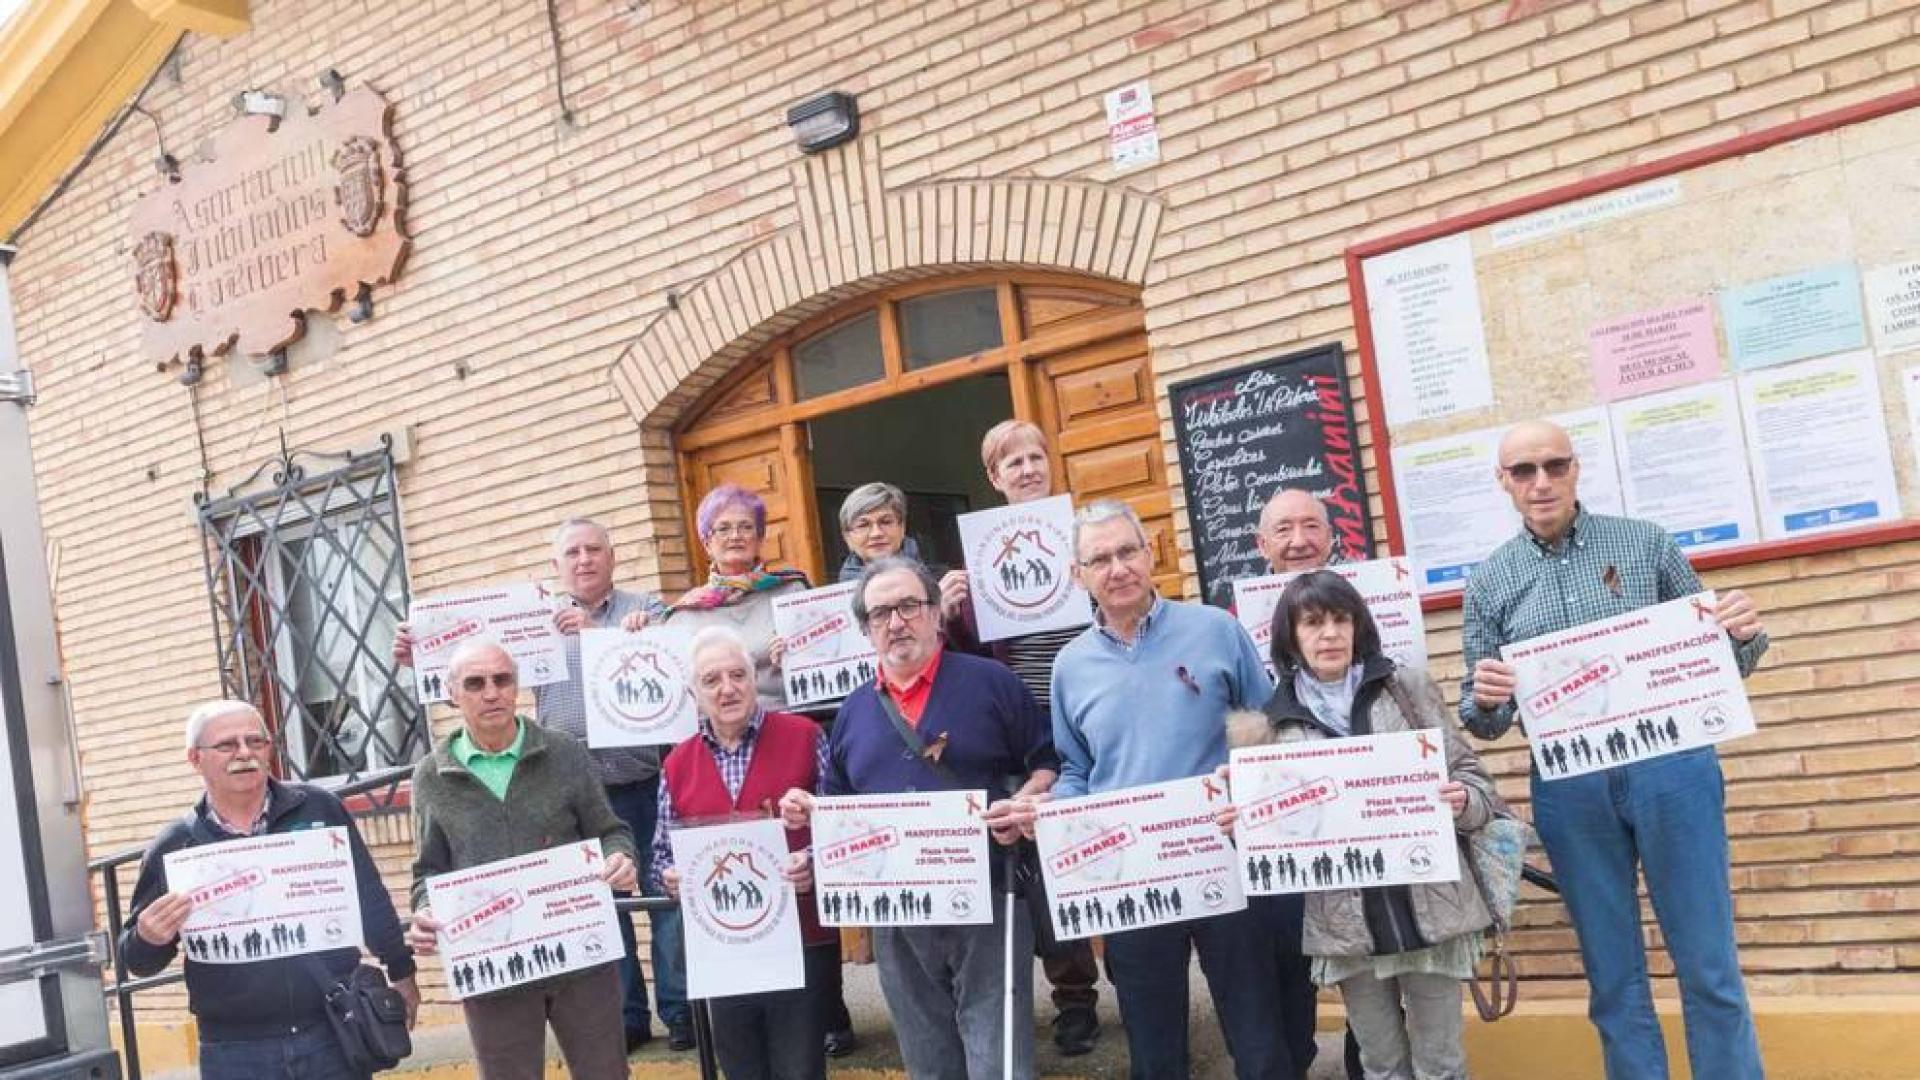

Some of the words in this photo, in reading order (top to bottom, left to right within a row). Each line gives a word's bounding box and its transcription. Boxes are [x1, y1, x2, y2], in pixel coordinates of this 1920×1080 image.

[1625, 632, 1720, 662] MANIFESTACIÓN
[1535, 690, 1558, 709] #17
[1562, 665, 1610, 696] MARZO
[1344, 771, 1439, 788] MANIFESTACIÓN
[1250, 804, 1273, 820] #17
[1278, 786, 1327, 811] MARZO
[904, 827, 982, 838] MANIFESTACIÓN
[1141, 812, 1216, 833] MANIFESTACIÓ
[1057, 853, 1078, 870] #17
[1082, 833, 1126, 859] MARZO
